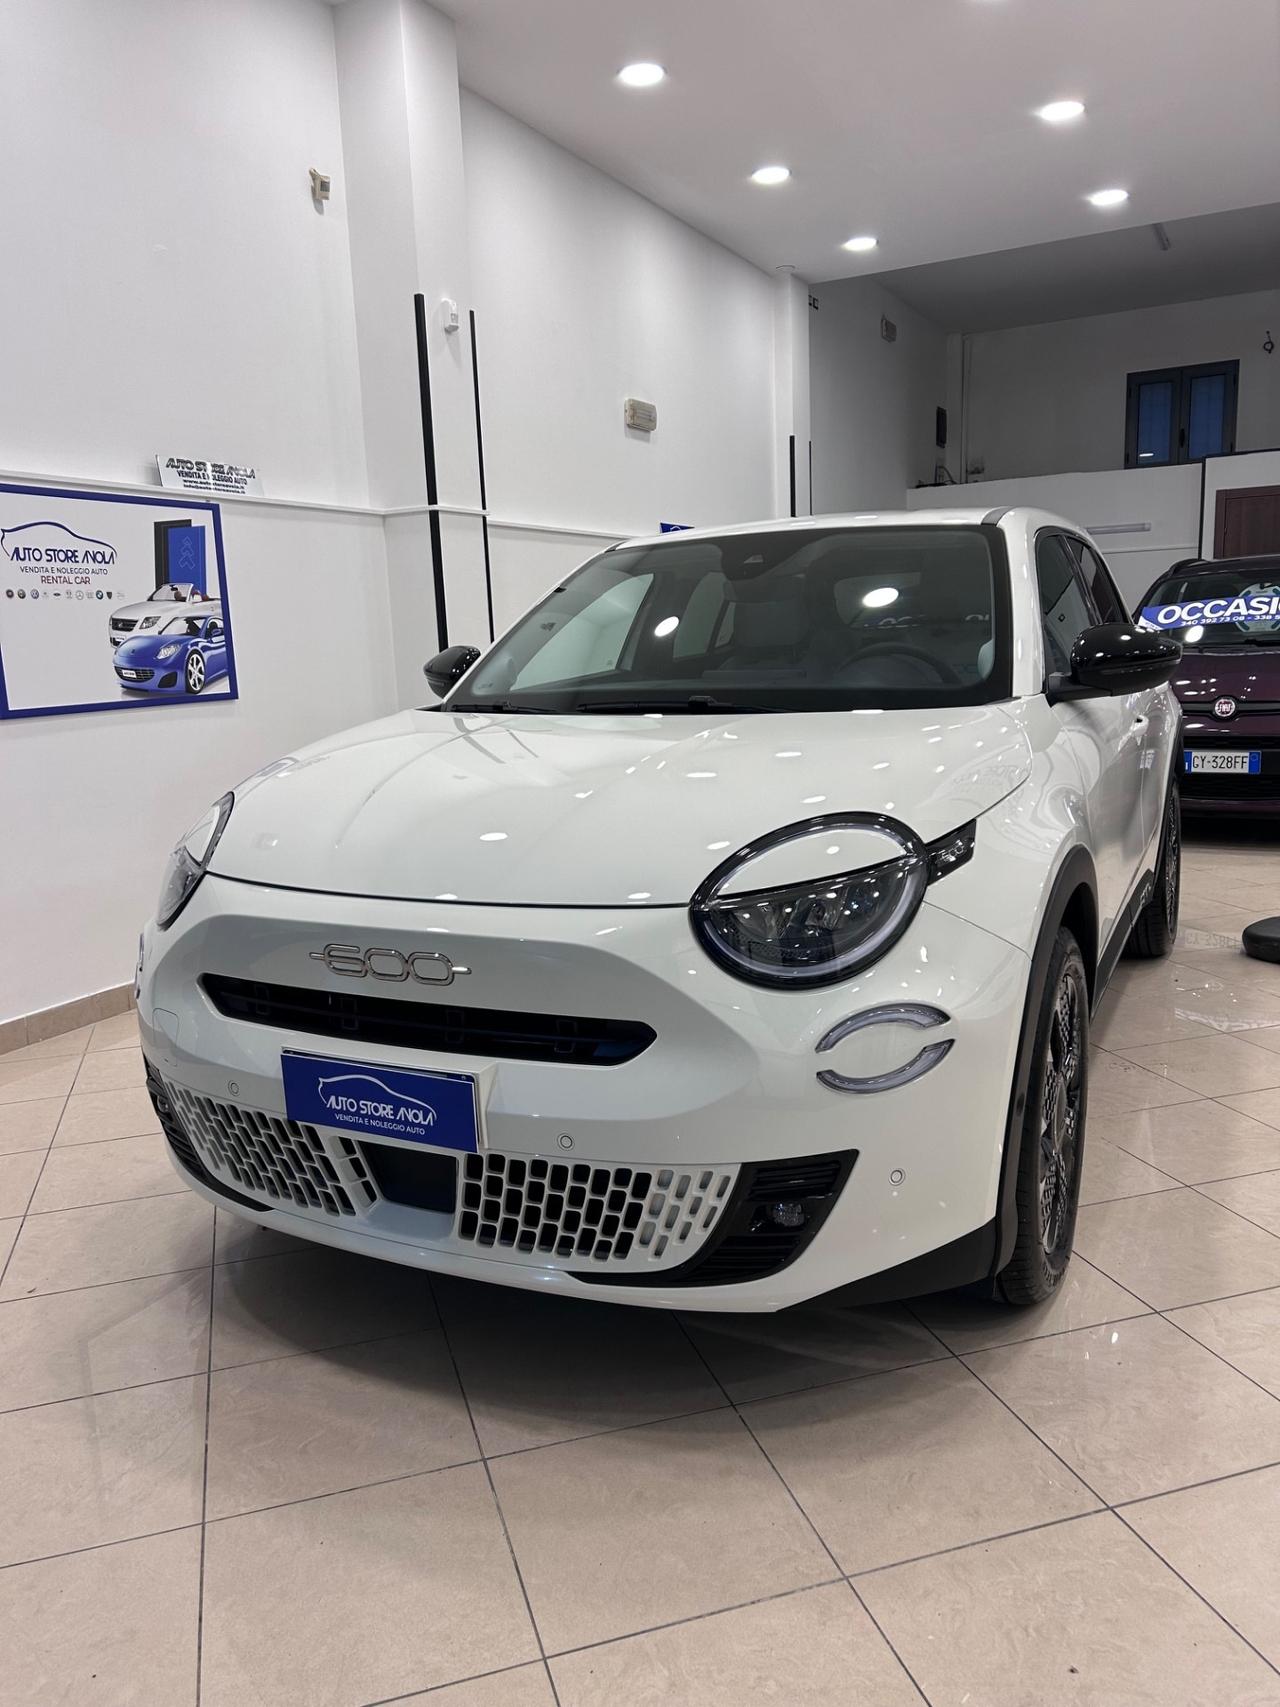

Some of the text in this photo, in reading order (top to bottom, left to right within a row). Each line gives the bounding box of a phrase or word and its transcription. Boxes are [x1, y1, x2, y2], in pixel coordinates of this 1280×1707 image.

[10, 547, 42, 562] AUTO
[45, 548, 79, 563] STORE
[20, 565, 49, 574] VENDITA
[57, 567, 90, 575] NOLEGGIO
[41, 575, 91, 584] RENTAL CAR
[1157, 597, 1280, 624] OCCASI
[320, 943, 457, 987] 600
[326, 1095, 357, 1112] AUTO
[360, 1100, 395, 1119] STORE
[335, 1113, 425, 1135] VENDITA E NOLEGGIO AUTO
